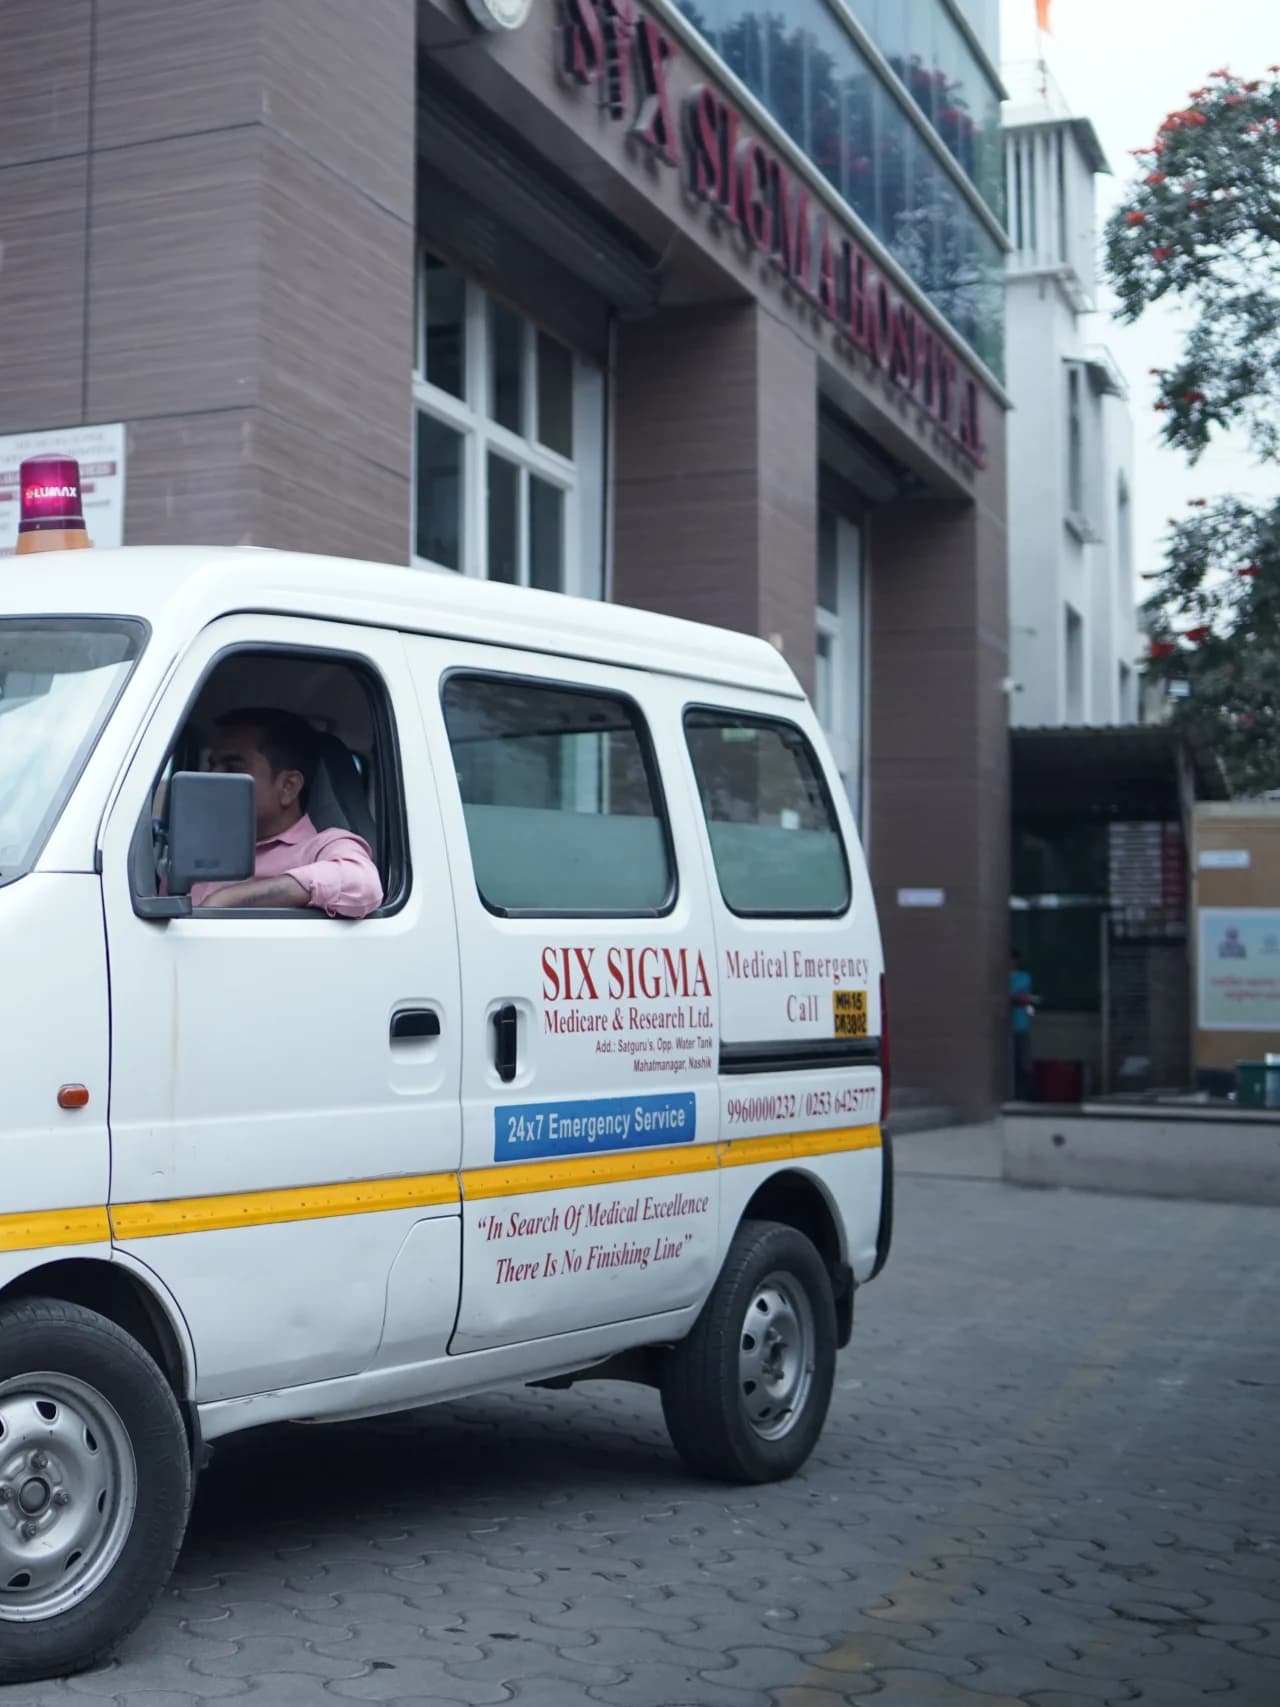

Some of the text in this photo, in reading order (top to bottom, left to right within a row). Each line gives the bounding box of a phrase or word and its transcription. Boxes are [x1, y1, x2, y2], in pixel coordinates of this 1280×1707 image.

[685, 83, 837, 320] SIGMA
[841, 239, 985, 471] HOSPITAL
[541, 946, 712, 1002] SIX SIGMA
[725, 950, 869, 985] Medical Emergency
[544, 1005, 713, 1035] Medicare & Research Ltd.
[786, 994, 819, 1023] Call
[657, 1038, 673, 1054] Opp.
[675, 1036, 696, 1049] Water
[697, 1036, 713, 1049] Tank
[688, 1056, 712, 1070] Nashik
[508, 1104, 686, 1143] 24x7 Emergency Service
[727, 1094, 796, 1124] 9960000232
[806, 1091, 831, 1117] 0253
[506, 1207, 560, 1239] Search
[564, 1204, 584, 1237] Of
[584, 1199, 640, 1229] Medical
[642, 1193, 709, 1222] Excellence
[495, 1257, 540, 1285] There
[542, 1252, 558, 1278] Is
[560, 1248, 583, 1276] No
[586, 1243, 651, 1271] Finishing
